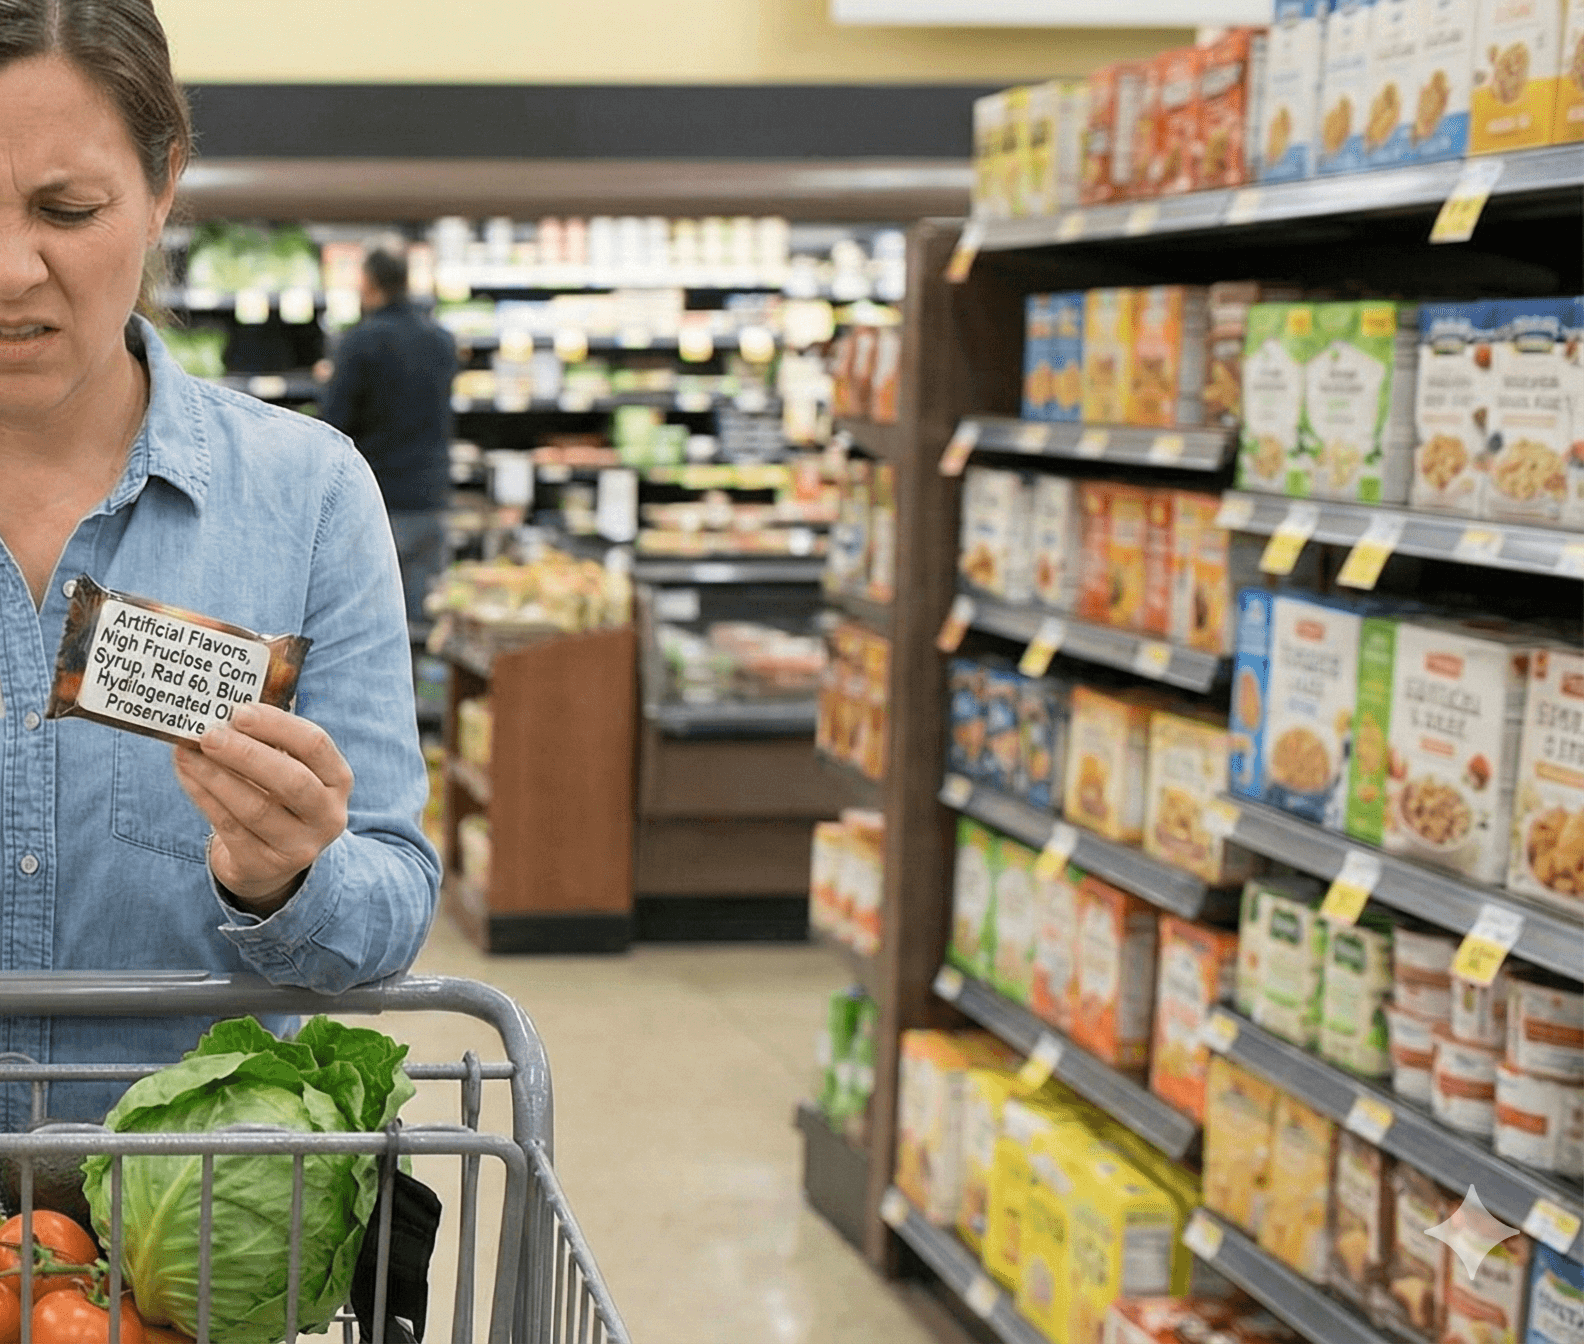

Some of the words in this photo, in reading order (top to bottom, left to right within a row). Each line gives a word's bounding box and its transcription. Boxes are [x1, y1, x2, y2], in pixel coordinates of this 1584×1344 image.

[113, 610, 185, 643] Artificial
[187, 630, 251, 665] Flavors,
[94, 647, 145, 679] Syrup,
[151, 663, 185, 686] Rad
[216, 681, 253, 704] Blue
